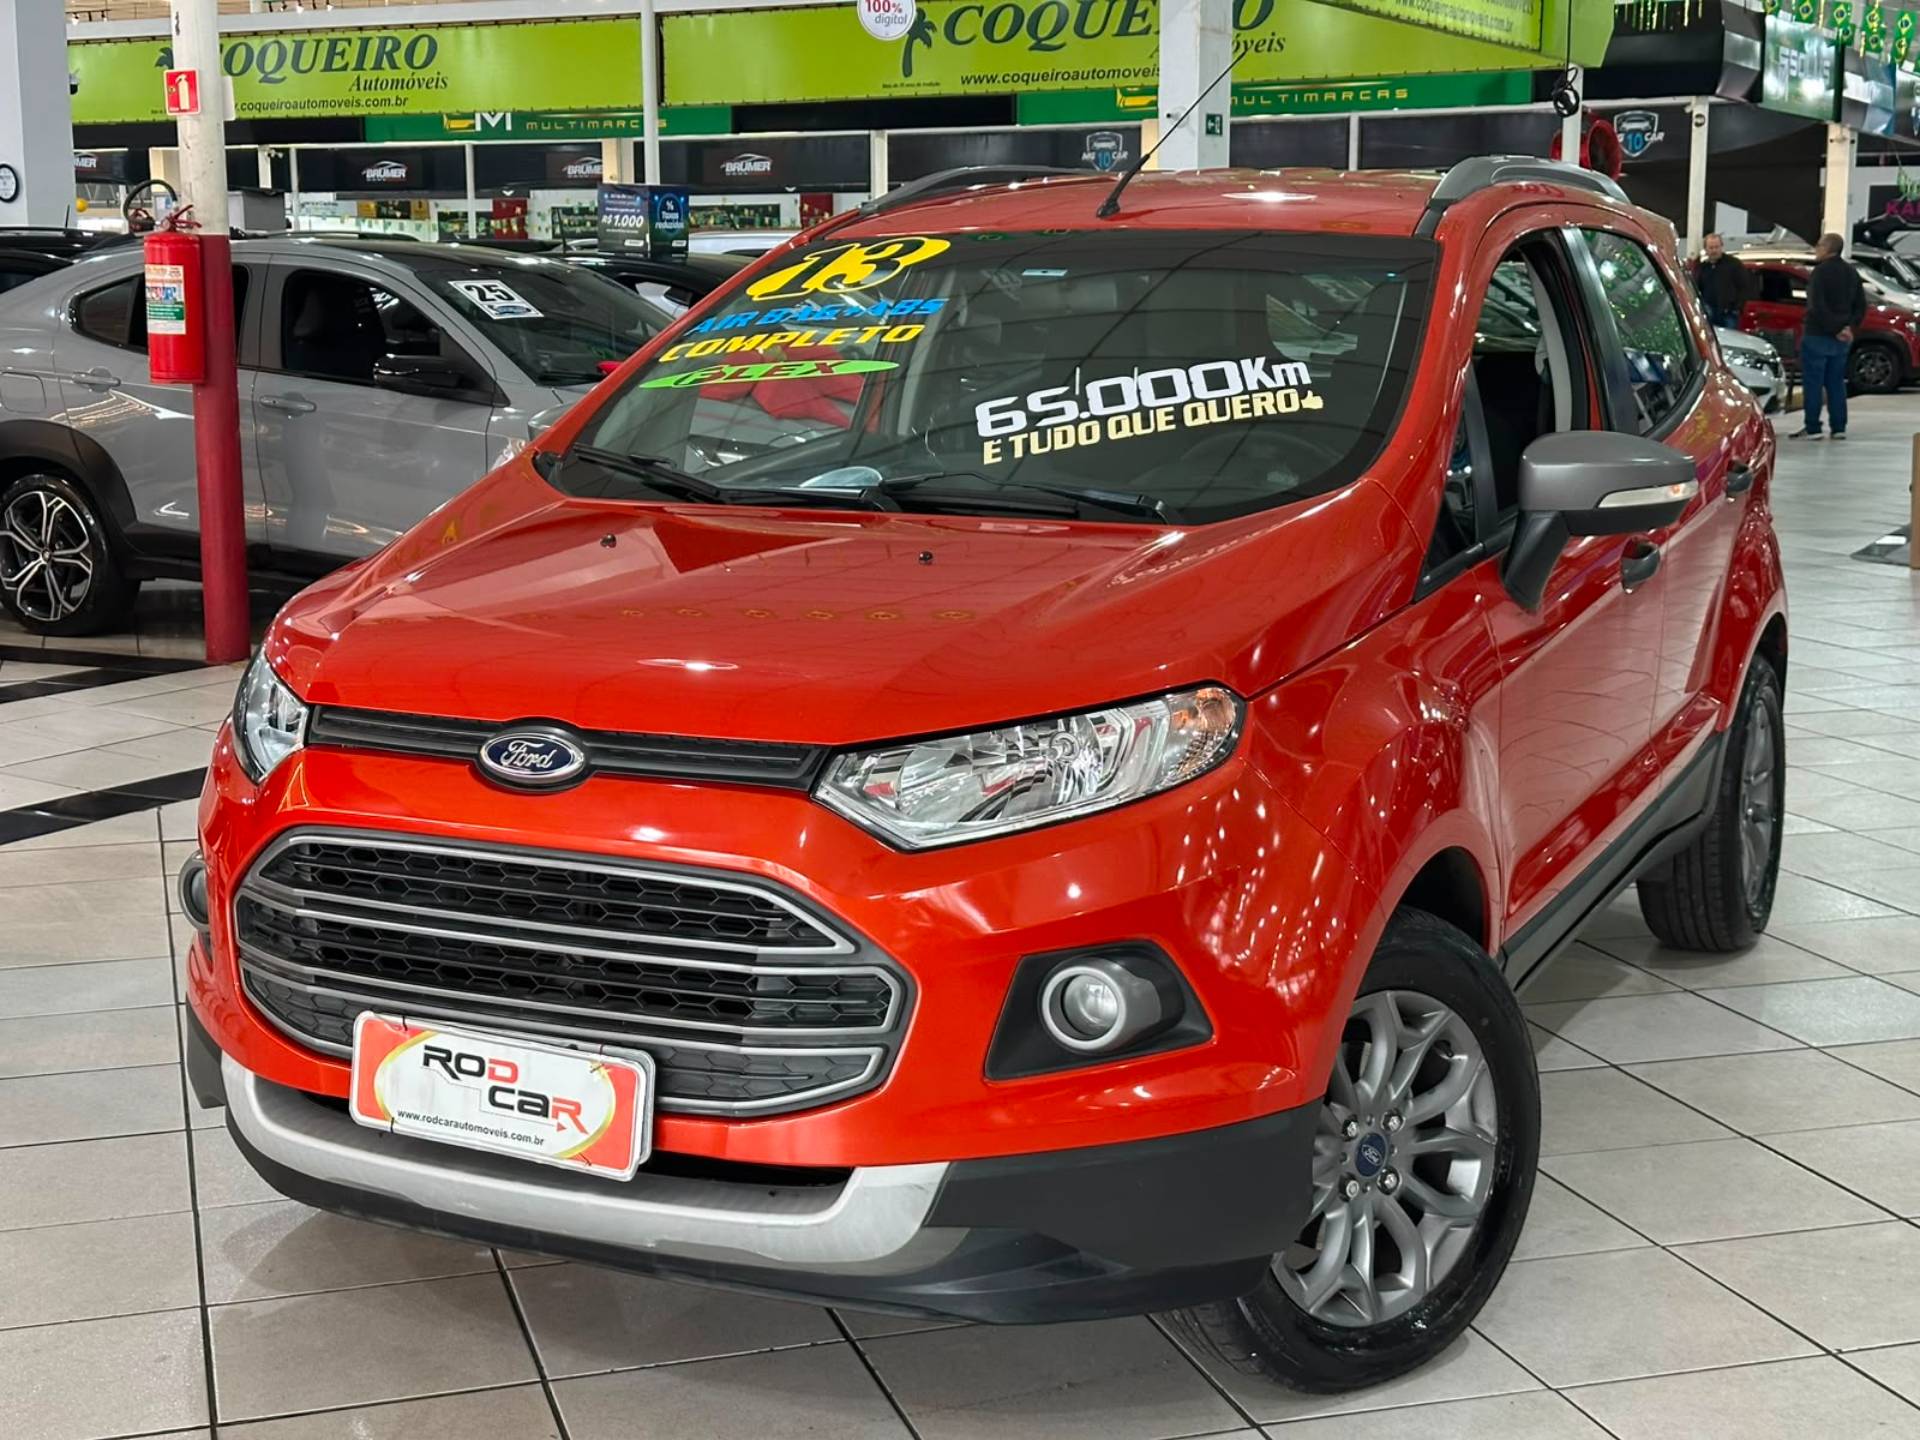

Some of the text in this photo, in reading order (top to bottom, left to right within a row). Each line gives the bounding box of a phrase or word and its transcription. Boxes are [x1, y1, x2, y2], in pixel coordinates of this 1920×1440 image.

[875, 13, 908, 27] digital
[944, 0, 1275, 51] COQUEO
[220, 34, 438, 84] OQUEIRO
[349, 71, 448, 92] Automóveis
[960, 66, 1160, 86] www.coqueiroautomovei
[235, 96, 408, 112] .coqueiroautomoveis.com.br
[526, 119, 668, 130] MULTIMARCS
[613, 214, 644, 228] 1.000
[464, 285, 515, 302] 25
[659, 324, 925, 362] COMPLETO
[1009, 420, 1101, 459] TUDO
[1107, 406, 1176, 440] QUE
[1182, 388, 1300, 427] QUERO
[500, 740, 558, 769] Ford
[397, 1108, 545, 1146] www.rodcarautomoveis.com.br
